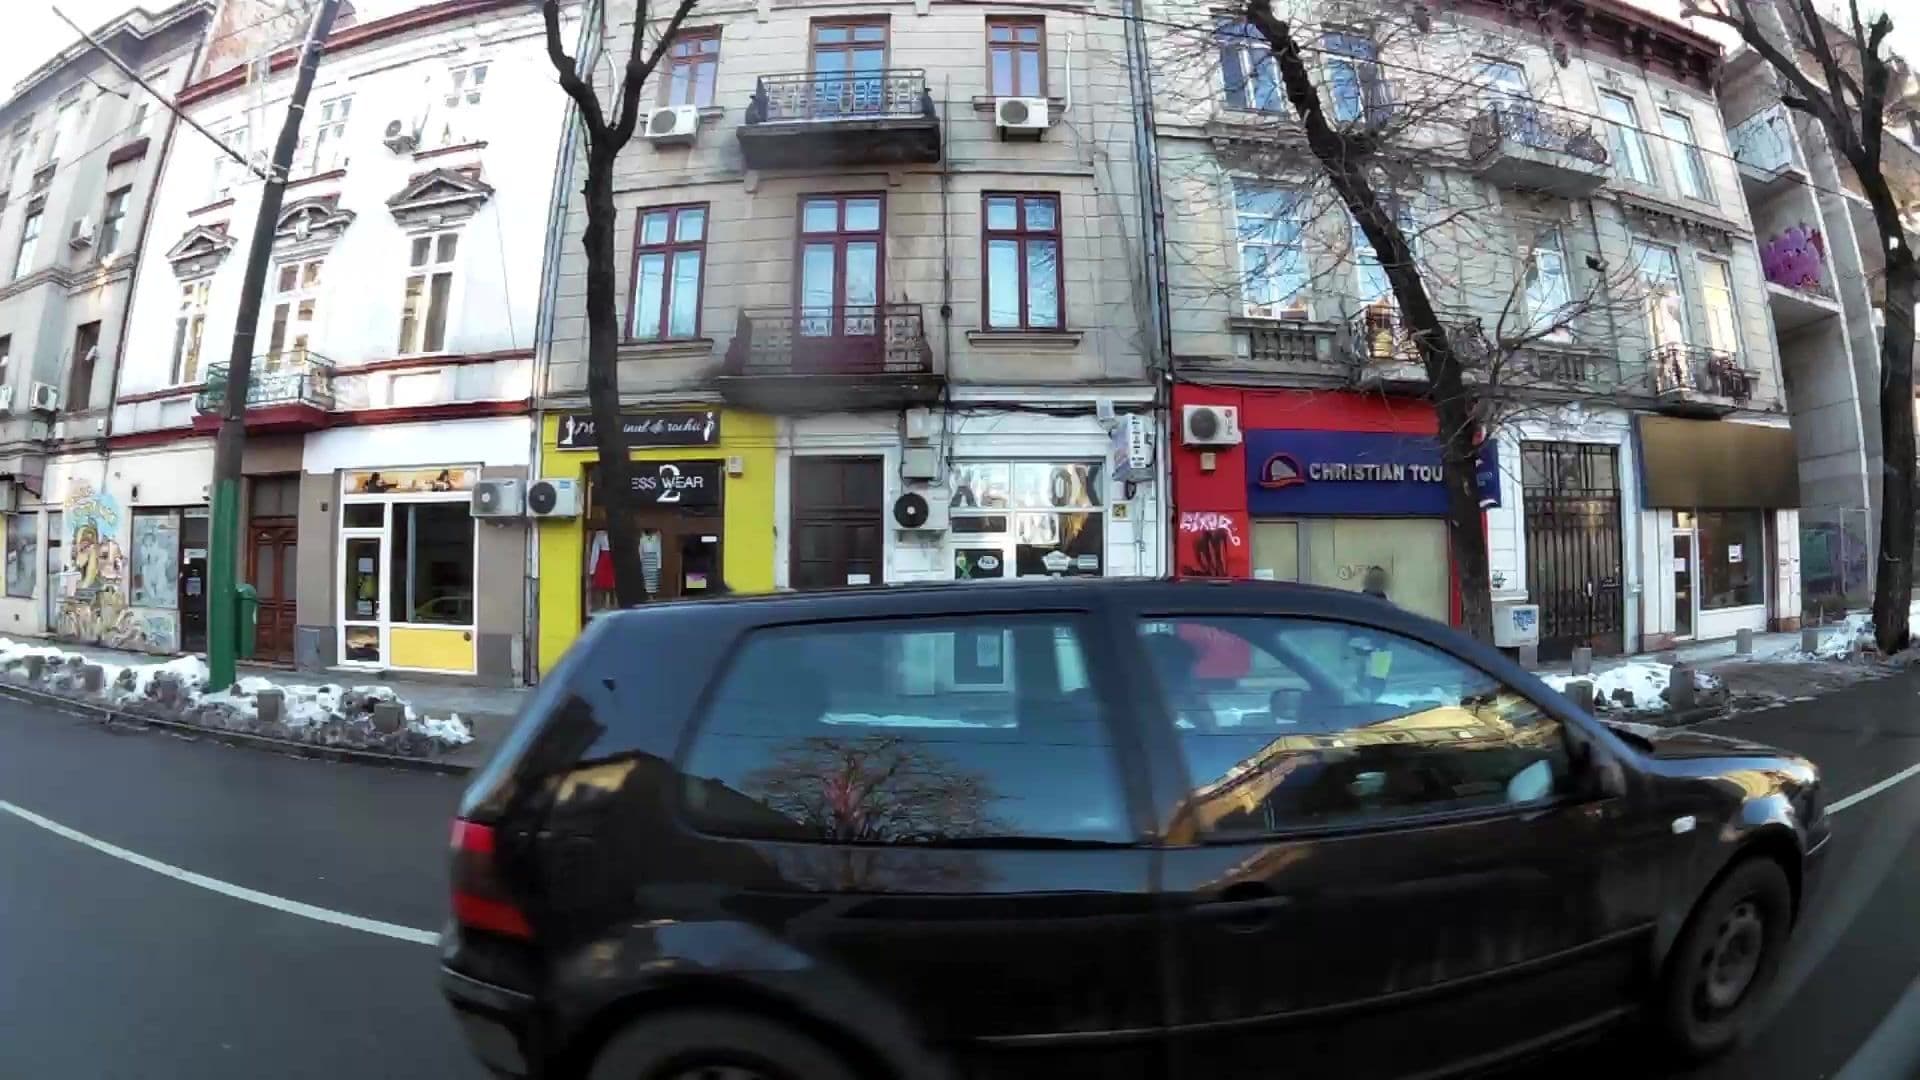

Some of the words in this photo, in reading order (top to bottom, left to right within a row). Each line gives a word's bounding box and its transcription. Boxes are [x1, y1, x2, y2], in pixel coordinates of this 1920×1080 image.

[1309, 463, 1404, 482] CHRISTIAN
[1410, 463, 1443, 482] TOU
[631, 477, 656, 490] ESS
[657, 464, 681, 502] 2
[661, 476, 704, 489] WEAR
